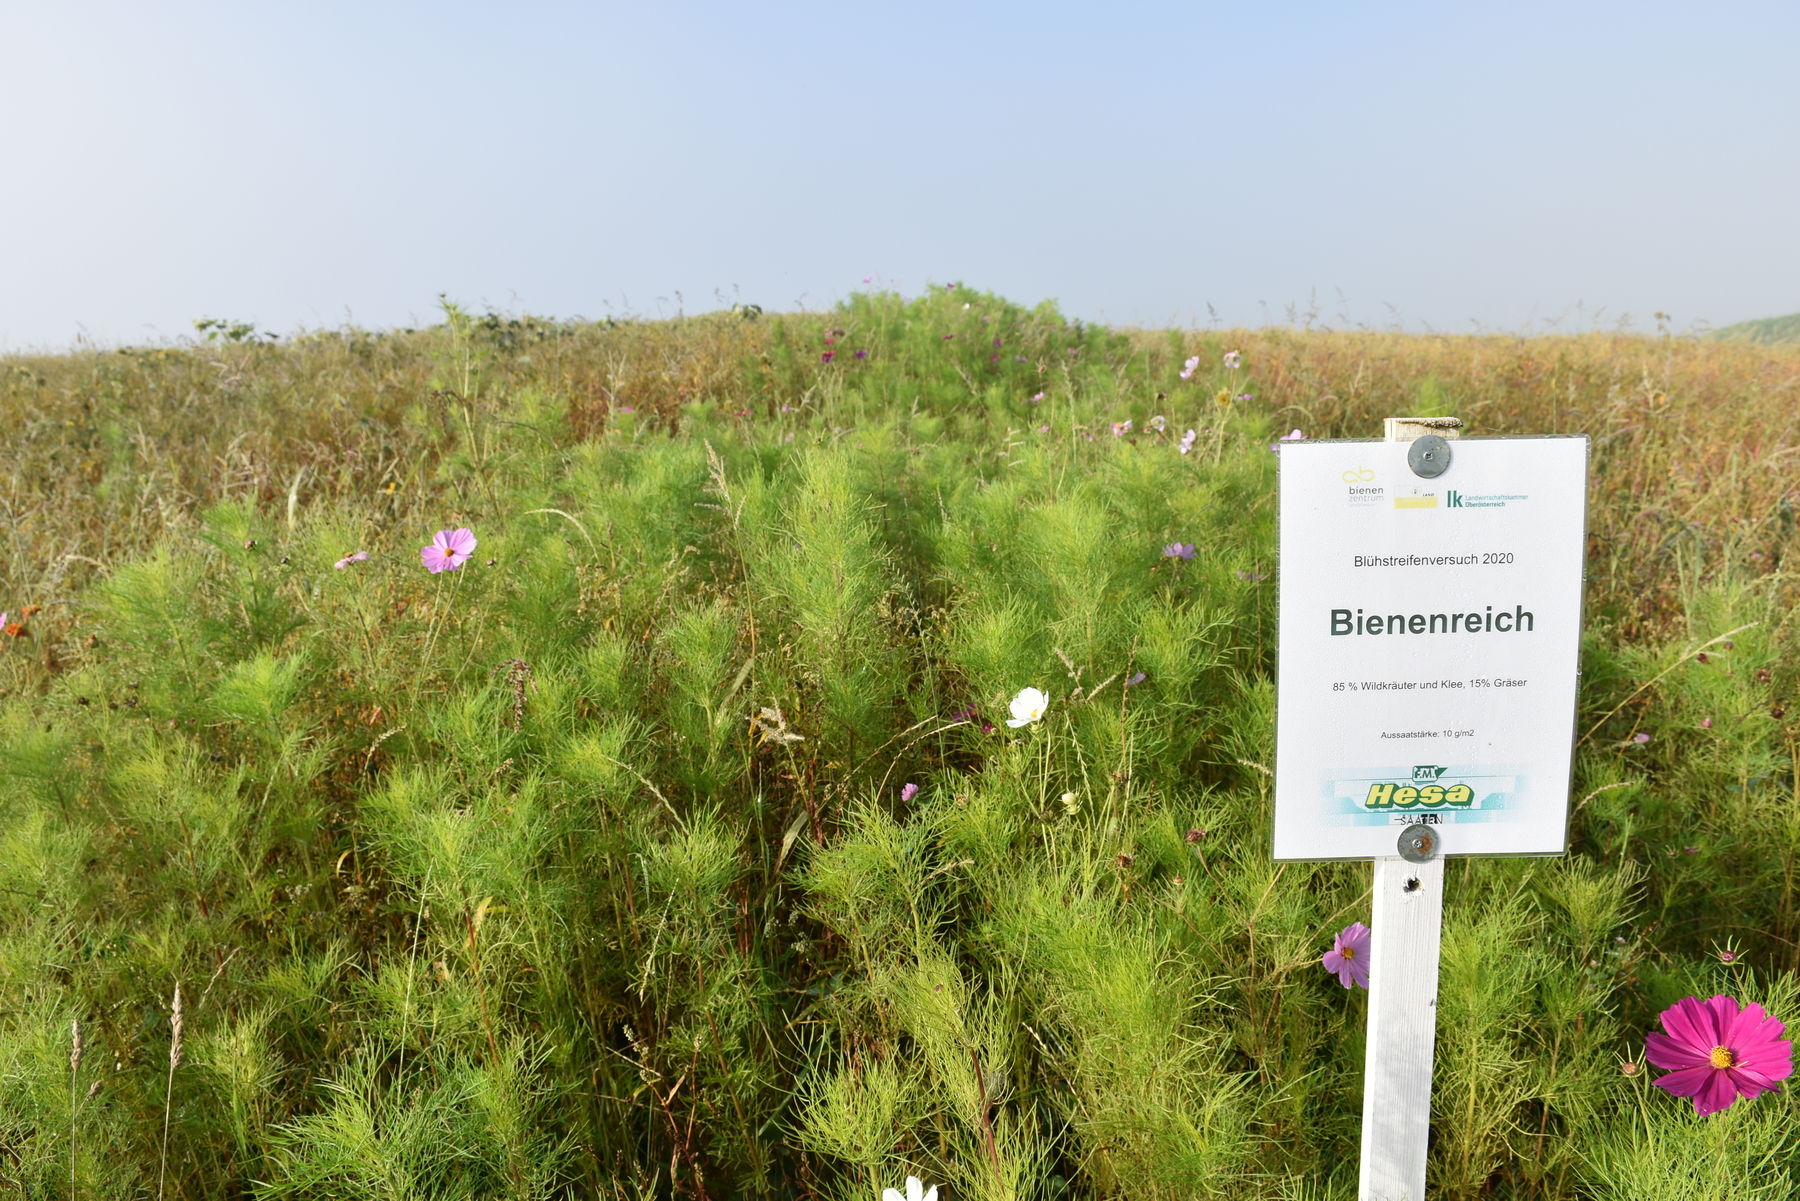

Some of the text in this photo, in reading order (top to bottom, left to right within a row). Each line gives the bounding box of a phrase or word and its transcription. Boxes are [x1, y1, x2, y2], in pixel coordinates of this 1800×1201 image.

[1349, 486, 1384, 495] bienen
[1349, 494, 1385, 503] zentrum
[1354, 552, 1514, 567] Blühstreifenversuch 2020
[1331, 605, 1534, 635] Bienenreich
[1332, 678, 1528, 691] 85 % Wildkräuter und Klee, 15% Gräser
[1381, 729, 1475, 739] Aussaatstärke: 10 g/m2
[1365, 783, 1475, 809] Hesa
